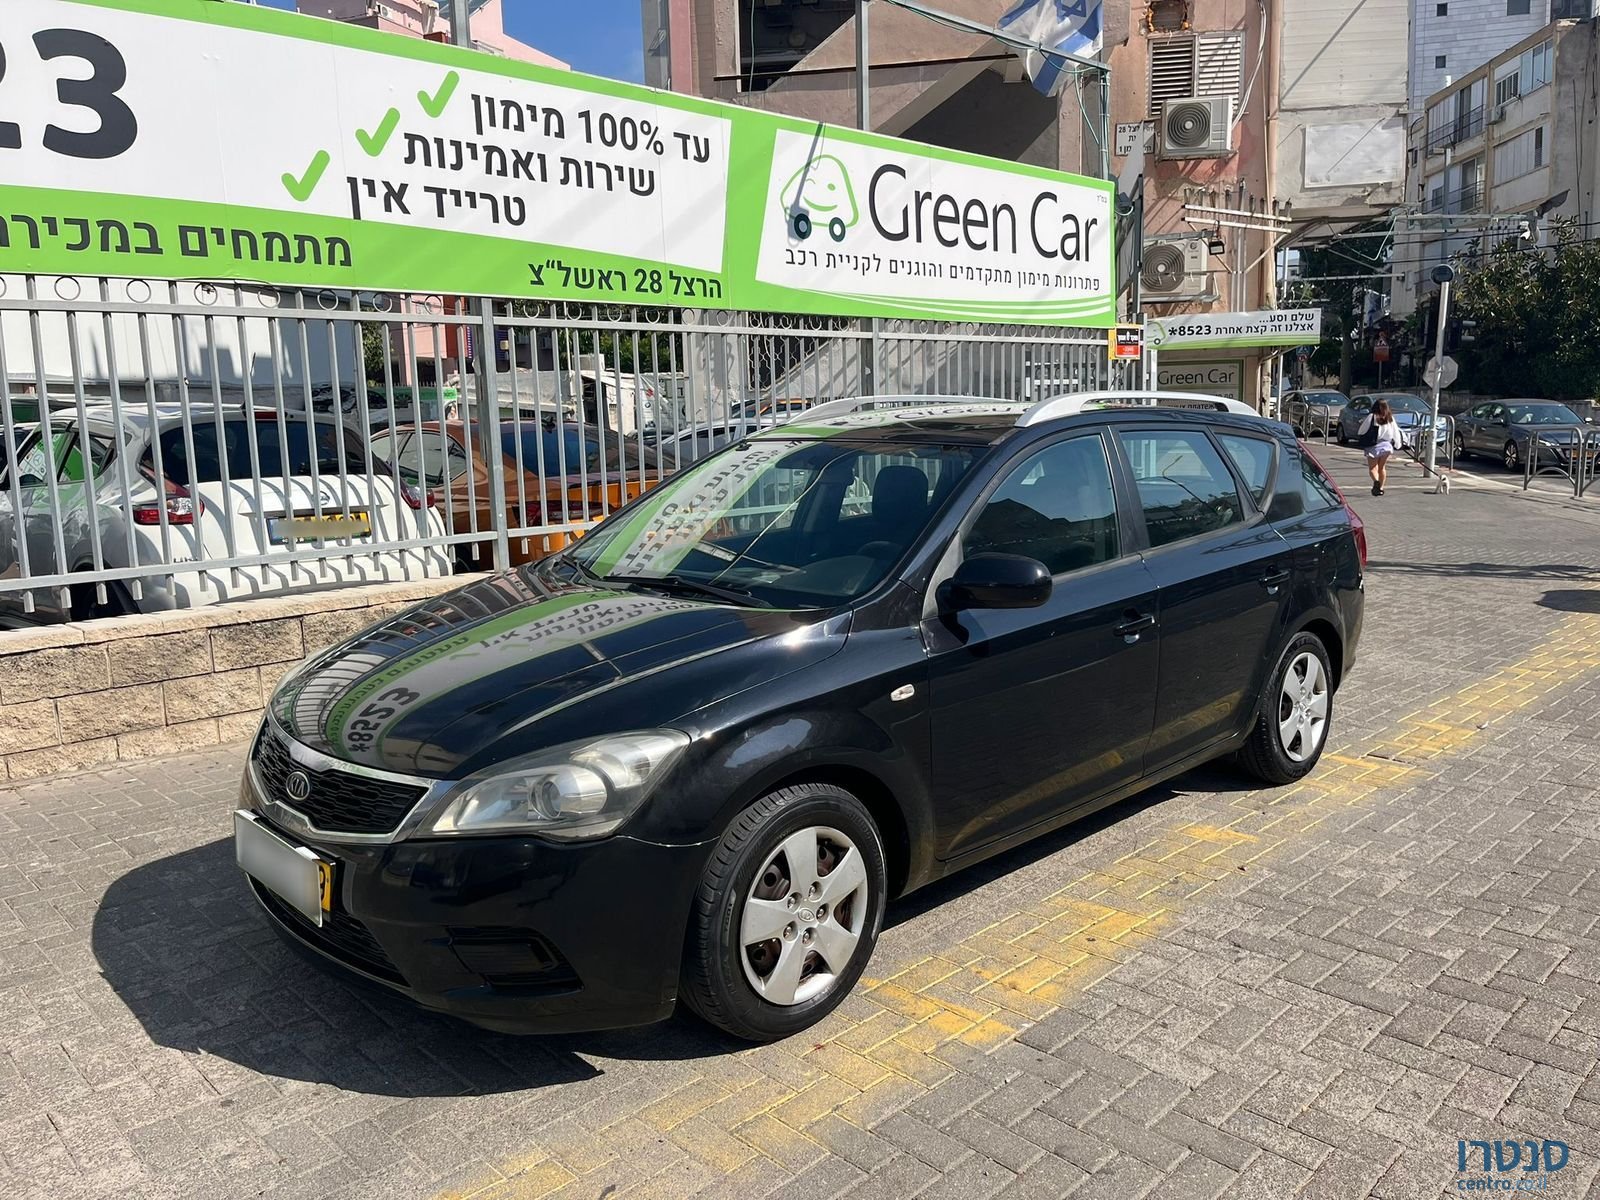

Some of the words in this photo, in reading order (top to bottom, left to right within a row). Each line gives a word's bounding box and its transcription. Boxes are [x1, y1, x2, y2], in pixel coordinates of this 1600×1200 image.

[0, 28, 138, 160] 3
[471, 93, 565, 140] מימון
[578, 109, 664, 157] 100%
[403, 132, 548, 184] ואמינות
[673, 132, 710, 163] עד
[559, 156, 655, 198] שירות
[346, 176, 411, 221] אין
[423, 185, 526, 226] טרייד
[868, 163, 1018, 255] Green
[1031, 191, 1099, 262] Car
[177, 224, 352, 268] מתמחים
[785, 248, 817, 267] רכב
[825, 252, 882, 276] לקניית
[889, 258, 943, 278] והוגנים
[949, 264, 1012, 286] מתקדמים
[633, 268, 663, 294] 28
[668, 270, 722, 299] הרצל
[1017, 271, 1050, 289] מימון
[1054, 274, 1100, 291] פתרונות
[1270, 324, 1282, 332] זה
[1285, 321, 1314, 332] אצלנו
[1290, 312, 1314, 322] שלם
[1214, 325, 1243, 335] אחרת
[1245, 324, 1267, 335] קצת
[1157, 370, 1204, 386] Green
[1207, 368, 1235, 384] Car
[288, 775, 305, 798] KIA
